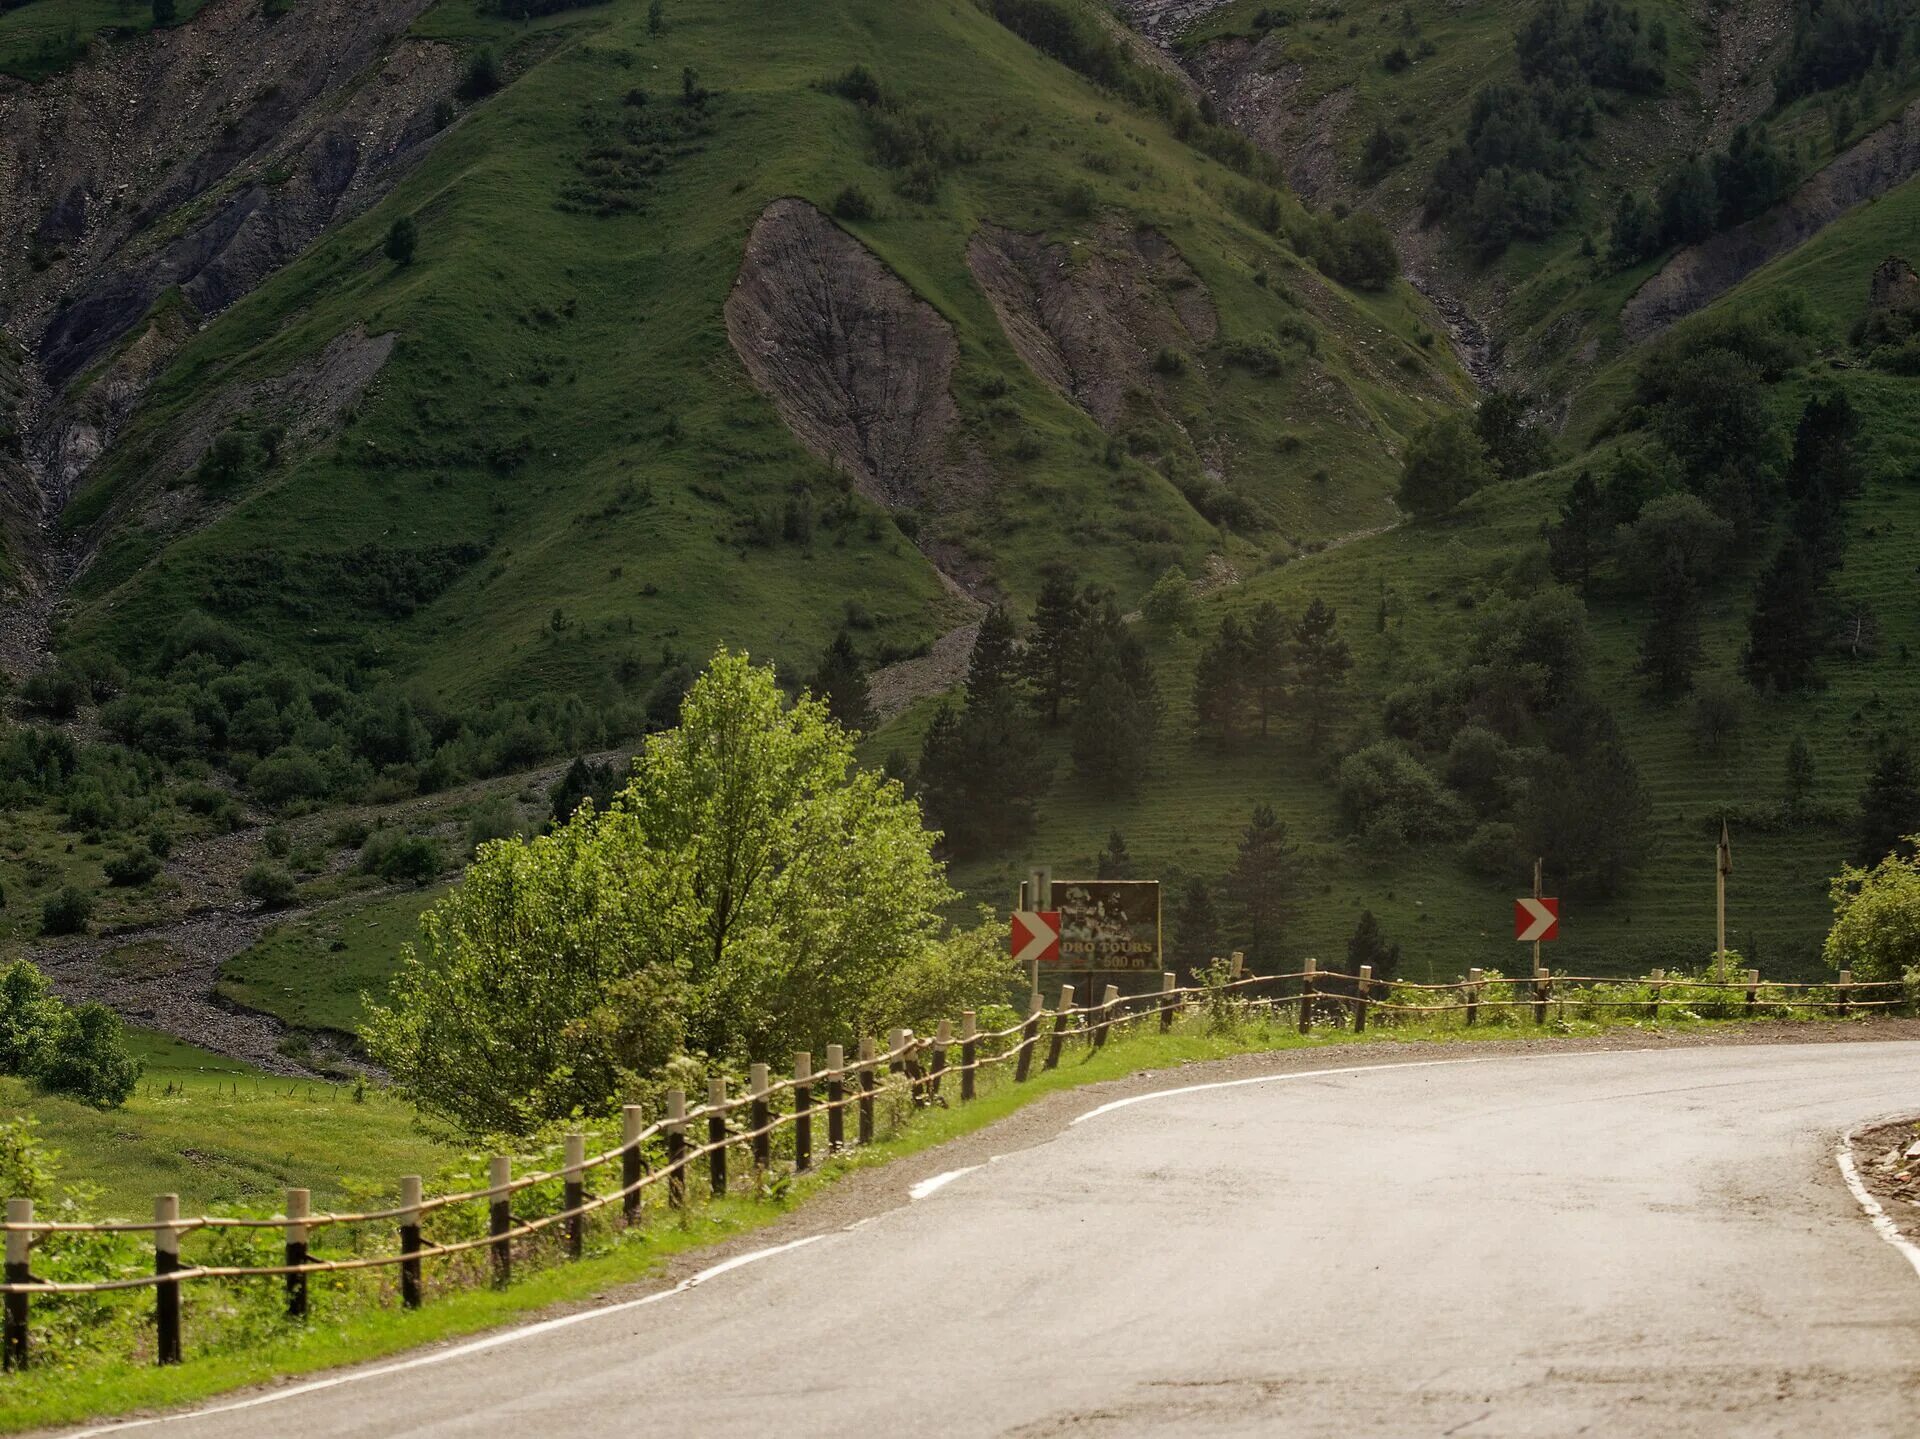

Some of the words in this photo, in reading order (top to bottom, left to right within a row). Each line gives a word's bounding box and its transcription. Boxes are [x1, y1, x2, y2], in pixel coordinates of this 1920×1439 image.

[1100, 942, 1152, 953] TOURS
[1103, 956, 1128, 967] 500
[1132, 958, 1145, 967] m
